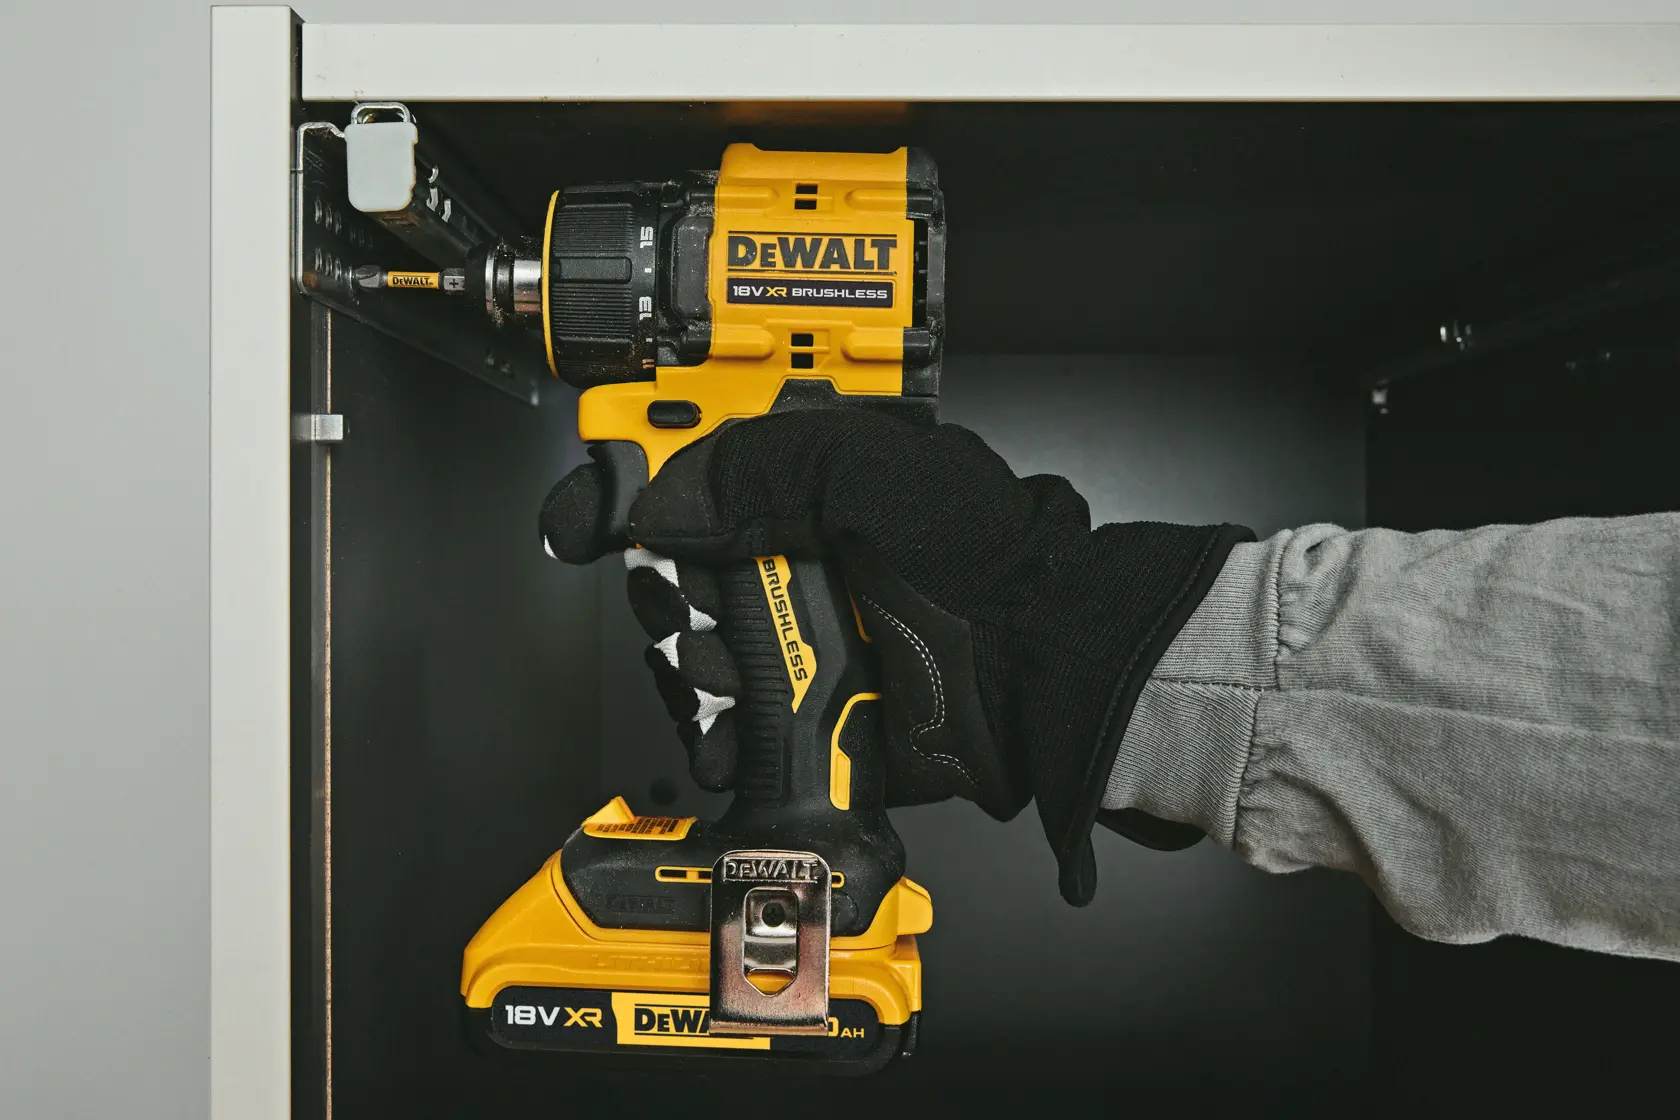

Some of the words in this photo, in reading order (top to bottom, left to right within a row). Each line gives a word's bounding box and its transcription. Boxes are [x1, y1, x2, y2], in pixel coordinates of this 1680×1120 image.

[639, 226, 654, 249] 15
[728, 235, 897, 270] DEWALT
[392, 276, 430, 286] DEWALT
[792, 287, 888, 299] BRUSHLESS
[638, 296, 653, 321] 13
[762, 558, 808, 682] BRUSHLESS
[724, 859, 818, 881] DEWALT
[505, 1005, 560, 1026] 18V
[564, 1007, 603, 1028] XR
[634, 1007, 710, 1034] DEW
